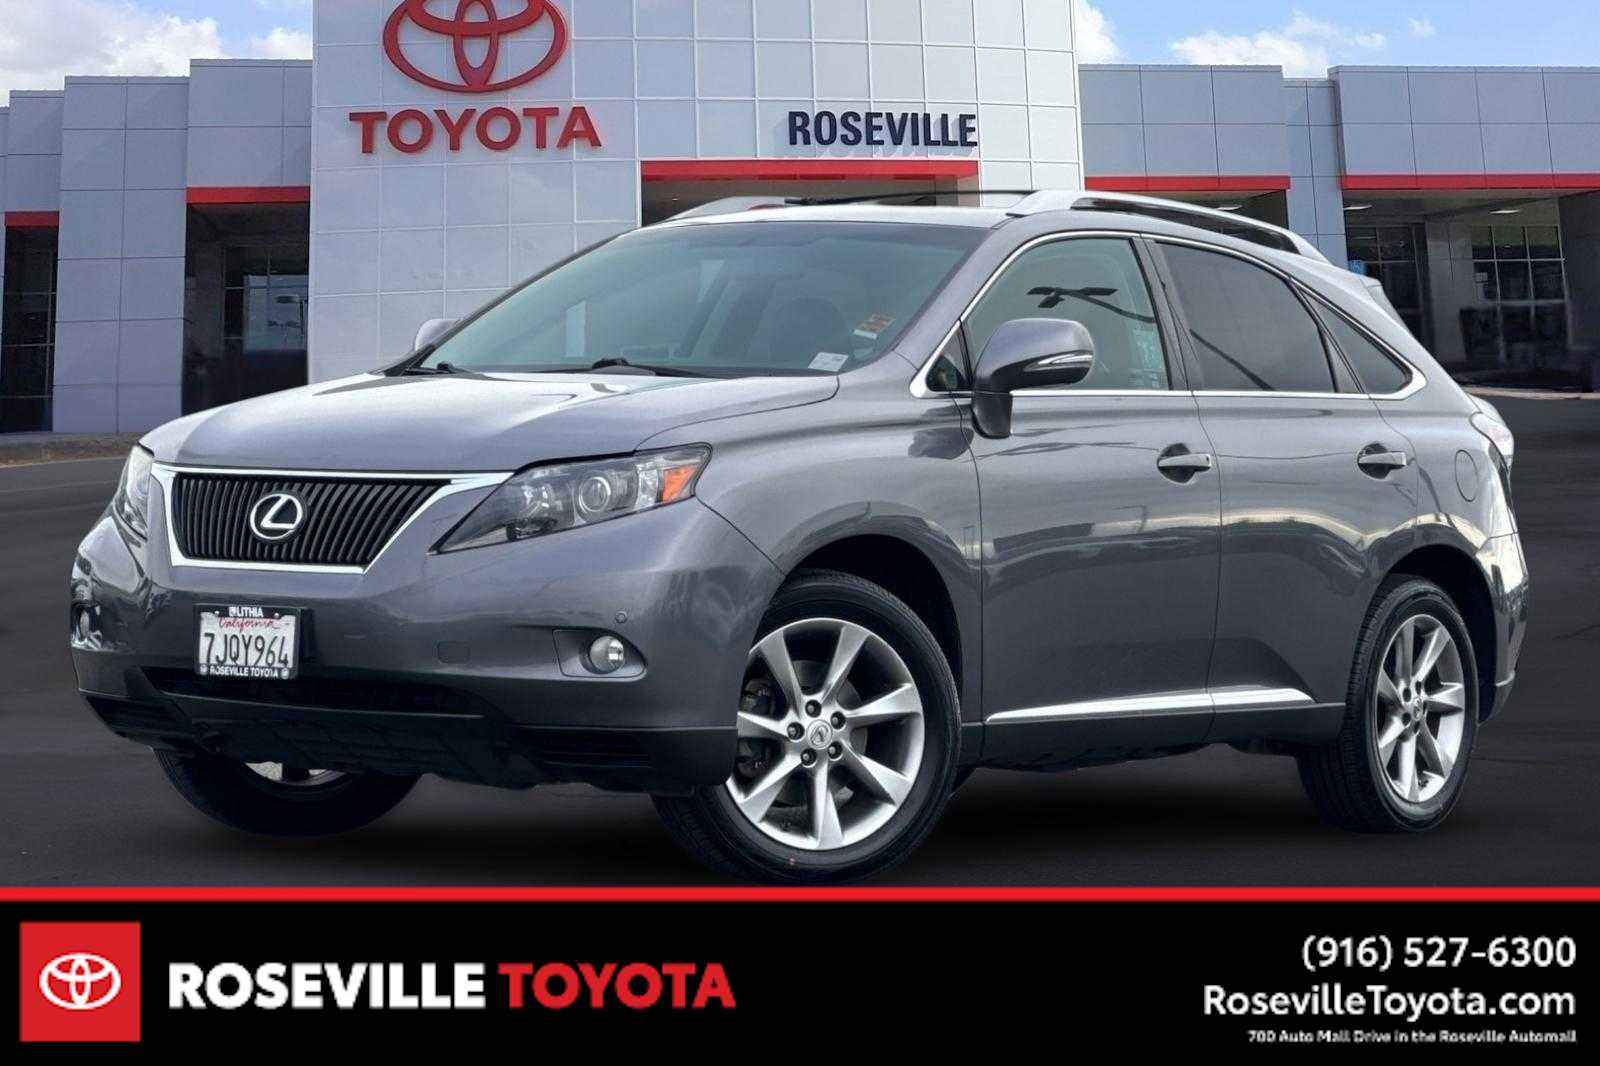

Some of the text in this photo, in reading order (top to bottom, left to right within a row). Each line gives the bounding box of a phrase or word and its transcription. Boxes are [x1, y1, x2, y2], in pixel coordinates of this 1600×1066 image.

[349, 105, 602, 154] TOYOTA
[788, 110, 978, 147] ROSEVILLE
[218, 616, 281, 633] California
[236, 606, 264, 618] LITHIA
[204, 632, 289, 668] 7JQY964
[209, 665, 279, 678] ROSEVILLE TOYOTA
